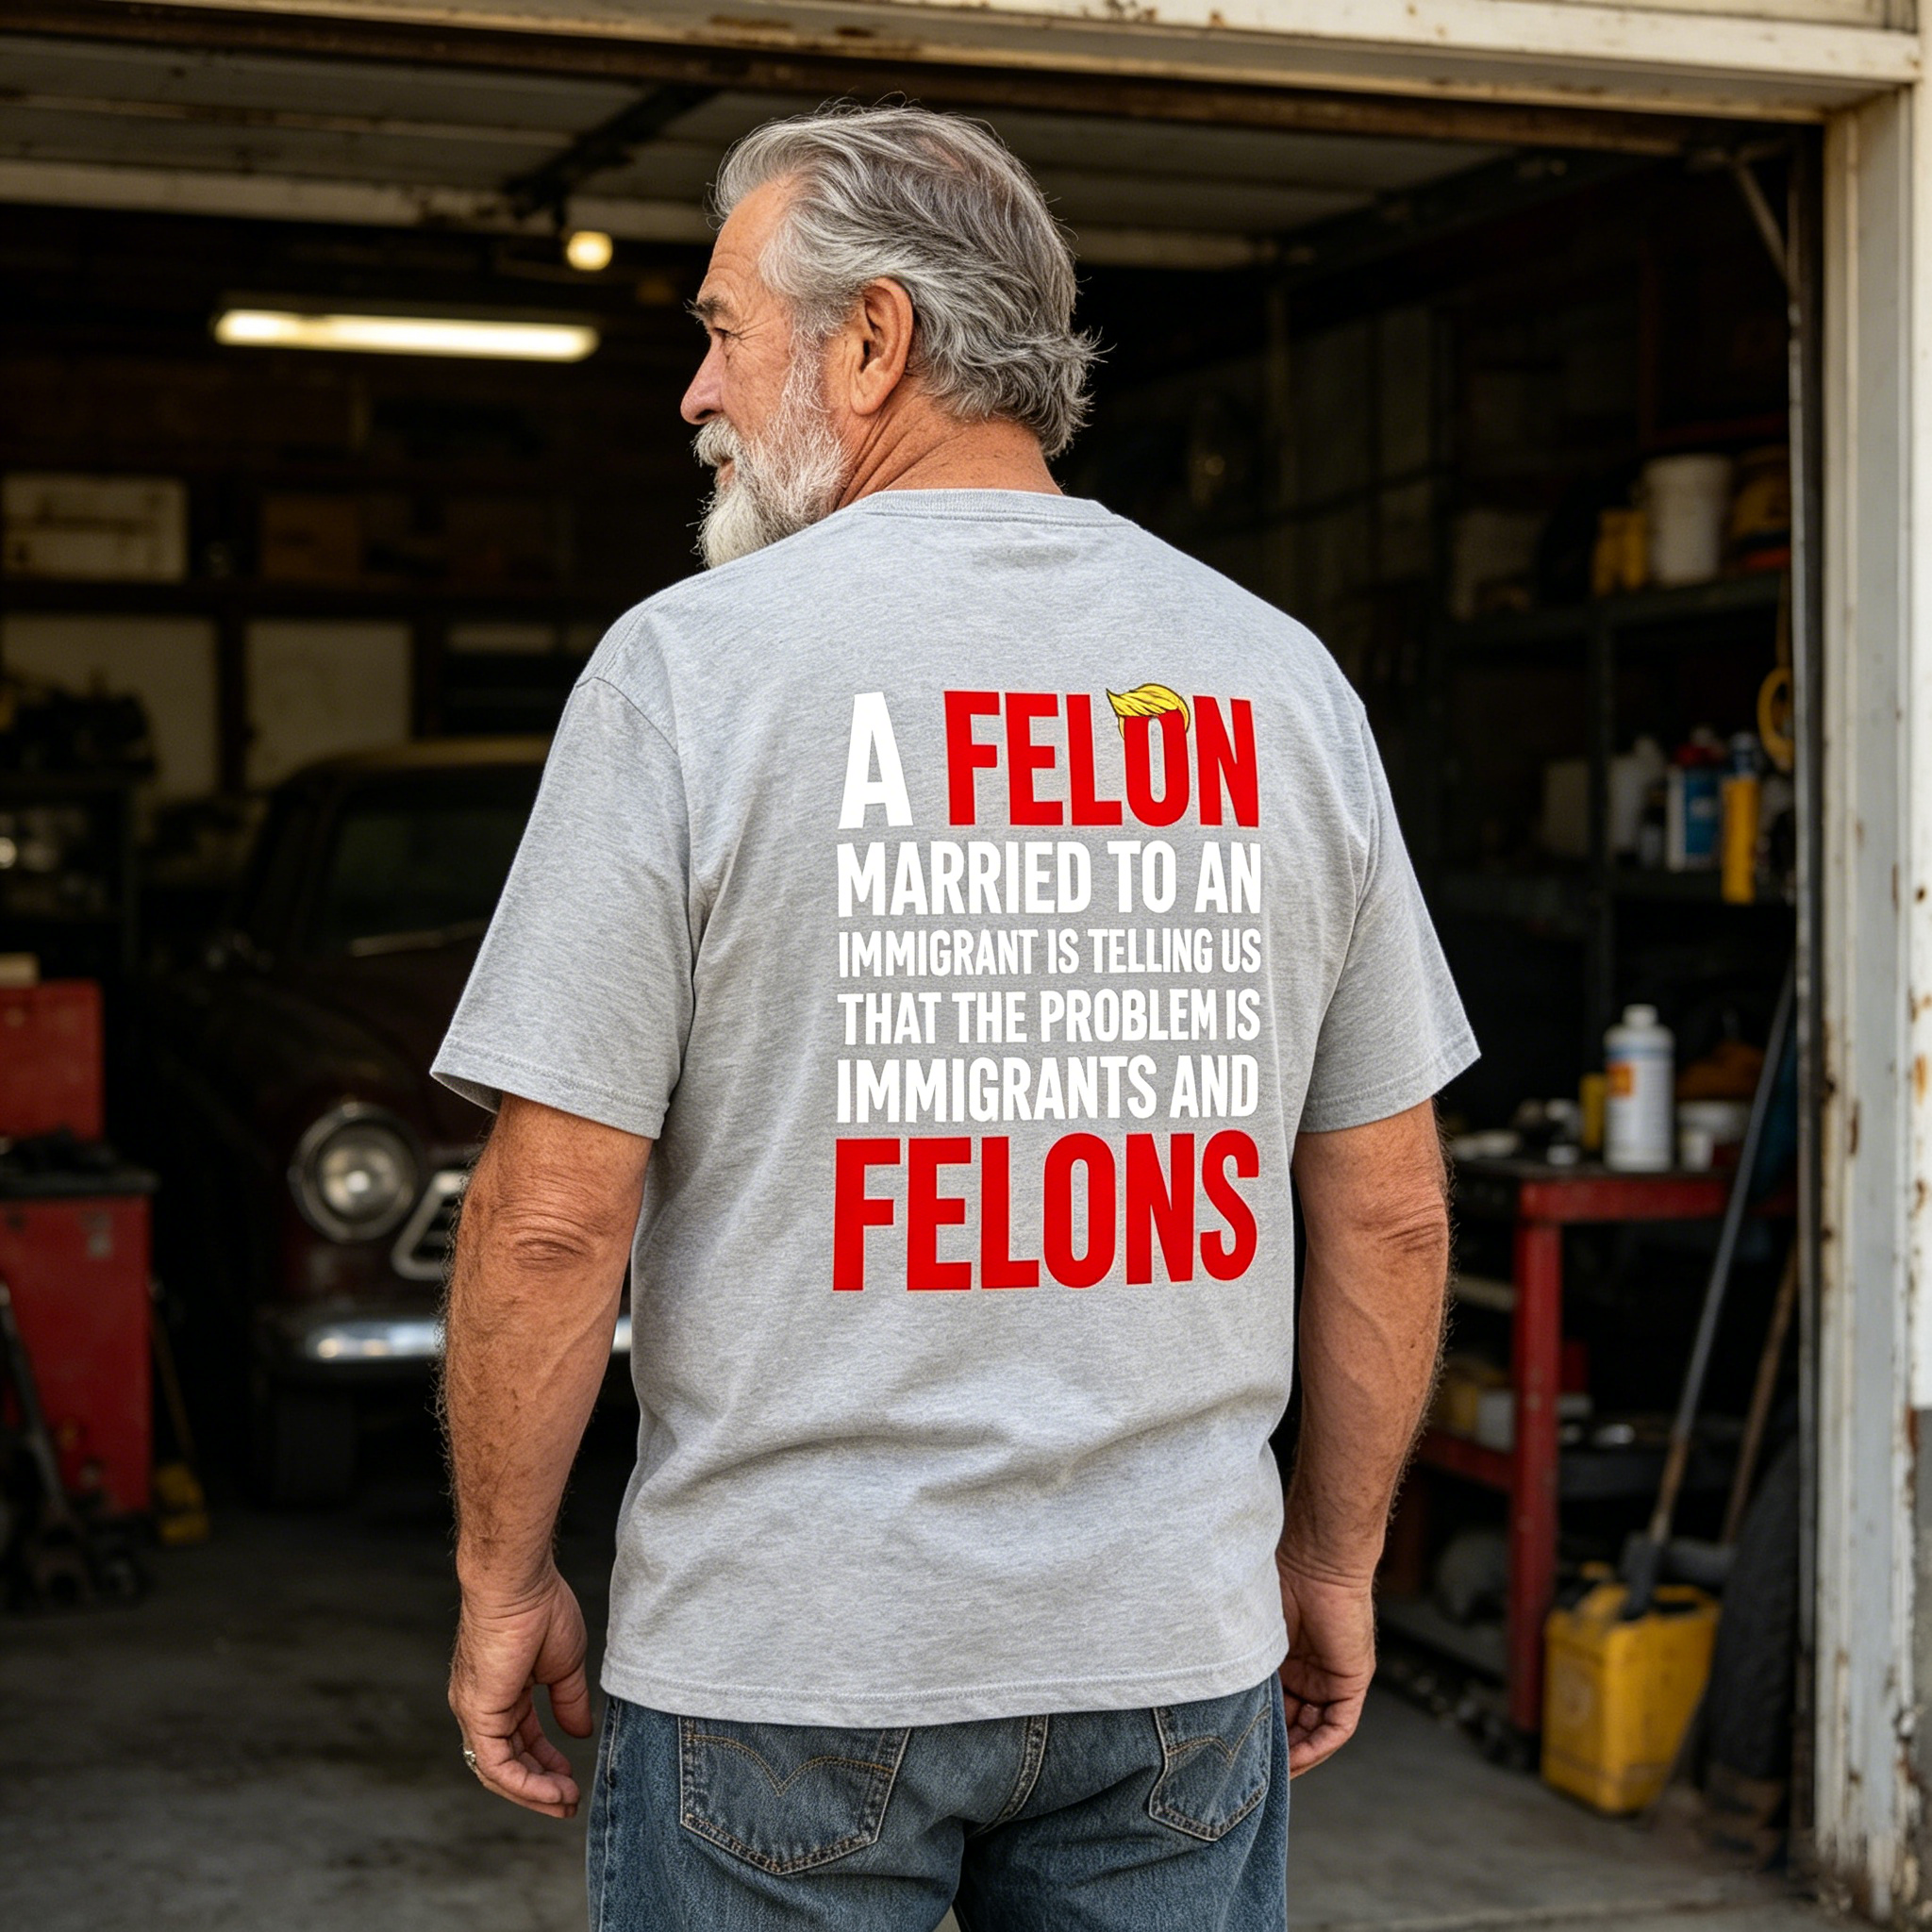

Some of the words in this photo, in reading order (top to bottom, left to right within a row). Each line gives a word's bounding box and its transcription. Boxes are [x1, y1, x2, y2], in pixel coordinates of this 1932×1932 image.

[837, 691, 914, 830] A
[943, 691, 1259, 828] FELON
[837, 841, 1091, 918] MARRIED
[1107, 840, 1176, 913] TO
[1194, 841, 1261, 914] AN
[839, 928, 1039, 978] IMMIGRANT
[1047, 927, 1079, 974] IS
[1087, 927, 1213, 974] TELLING
[1222, 928, 1261, 974] US
[837, 991, 942, 1045] THAT
[951, 991, 1027, 1043] THE
[1040, 988, 1217, 1042] PROBLEM
[1225, 988, 1260, 1041] IS
[837, 1054, 1158, 1124] IMMIGRANTS
[1169, 1054, 1258, 1119] AND
[832, 1129, 1259, 1291] FELONS
